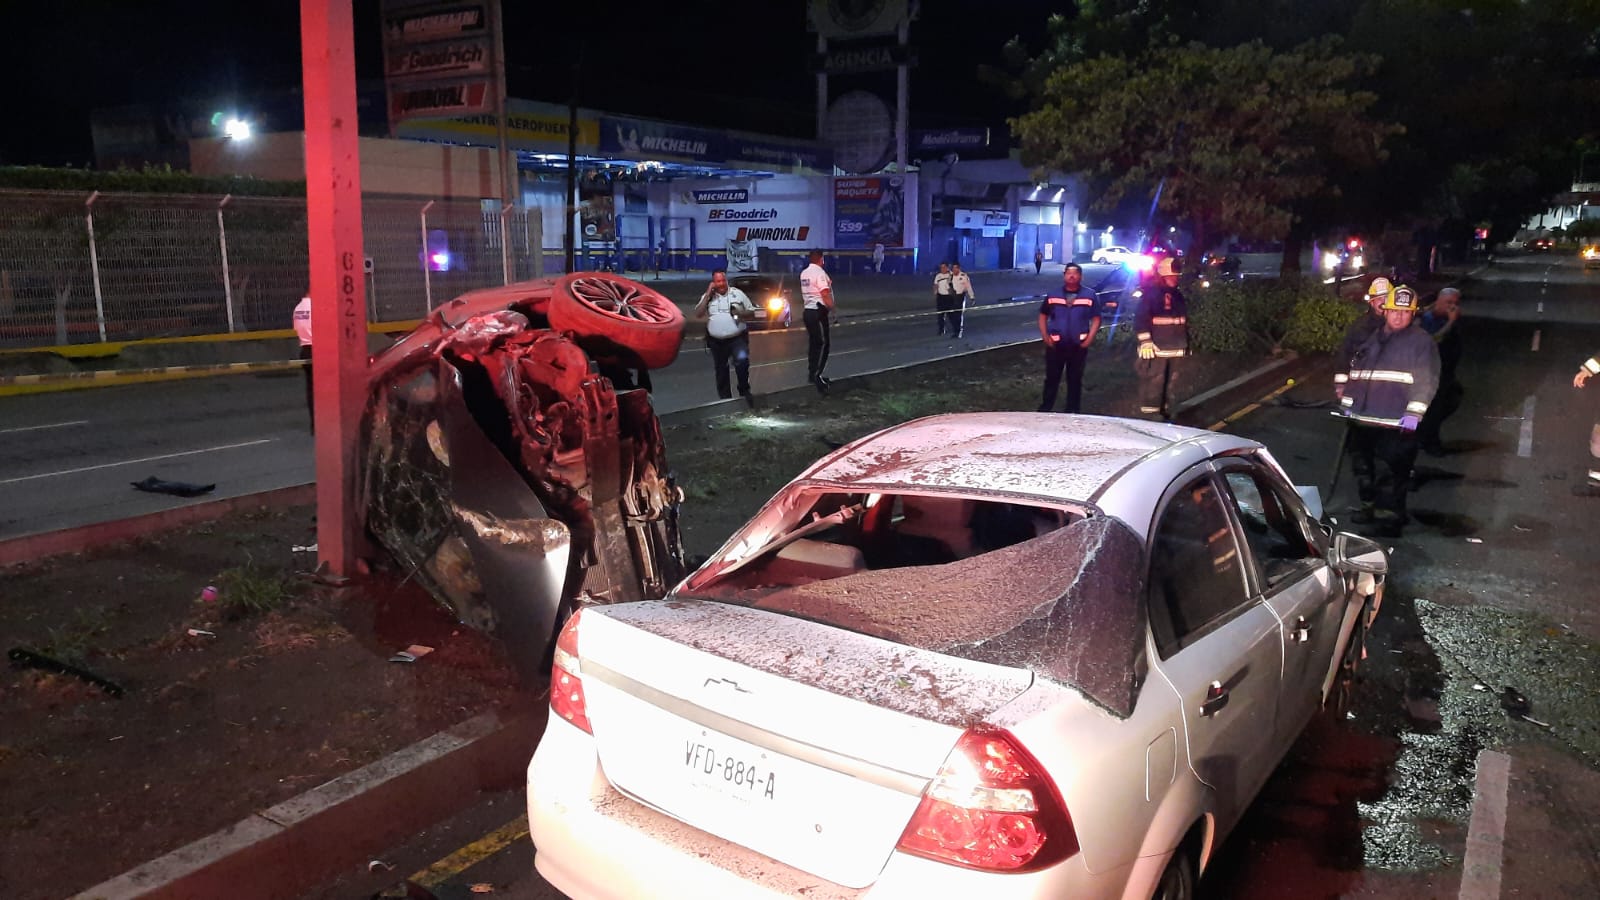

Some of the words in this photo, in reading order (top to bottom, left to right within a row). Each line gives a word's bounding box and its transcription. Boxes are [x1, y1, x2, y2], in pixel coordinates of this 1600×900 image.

[823, 49, 893, 69] AGENCIA
[641, 136, 708, 154] MICHELIN
[697, 190, 746, 201] MICHELIN
[708, 208, 778, 219] BFGoodrich
[747, 227, 796, 241] UNIROYAL
[685, 740, 775, 800] VFD-884-A
